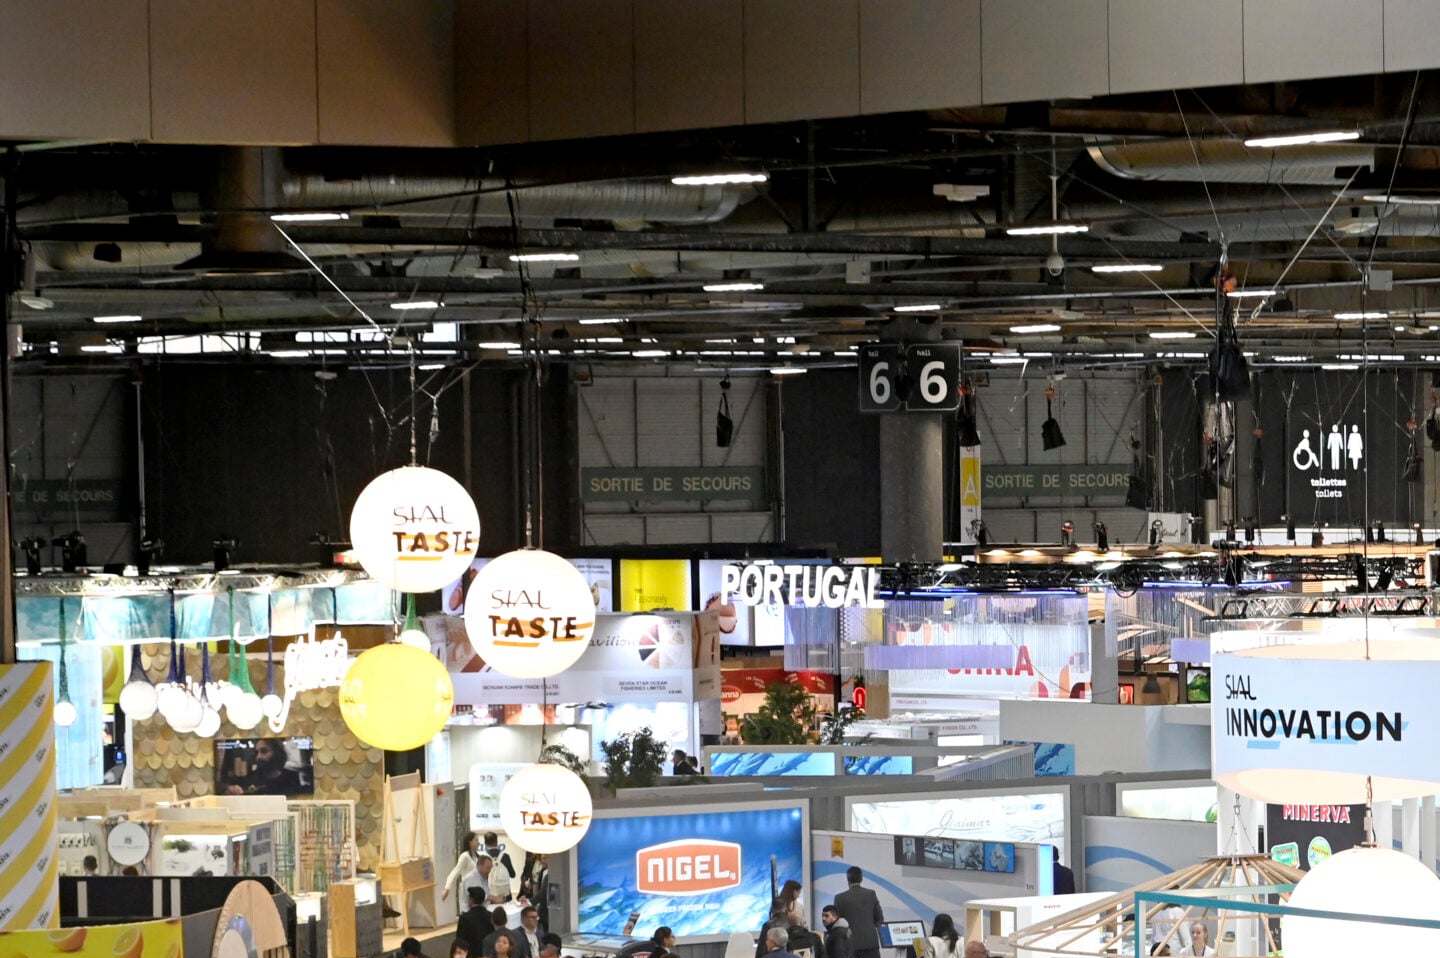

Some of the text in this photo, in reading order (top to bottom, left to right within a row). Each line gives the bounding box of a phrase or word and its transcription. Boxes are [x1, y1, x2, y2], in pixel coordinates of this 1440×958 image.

[916, 349, 931, 357] hall
[869, 361, 891, 404] 6
[919, 360, 948, 404] 6
[590, 477, 751, 493] SORTIE DE SECOURS
[963, 474, 978, 499] A
[985, 472, 1131, 489] SORTIE DE SECOURS
[1310, 477, 1347, 487] toilettes
[1315, 488, 1343, 498] toilets
[392, 504, 454, 526] SIAL
[391, 530, 473, 554] TASTE
[720, 563, 886, 609] PORTUGAL
[490, 588, 553, 611] SIAL
[488, 615, 578, 642] TASTE
[1225, 673, 1258, 701] SIAL
[1225, 706, 1403, 742] INNOVATION
[519, 810, 580, 827] TASTE
[1282, 804, 1352, 825] MINERVA
[647, 853, 731, 884] NIGEL
